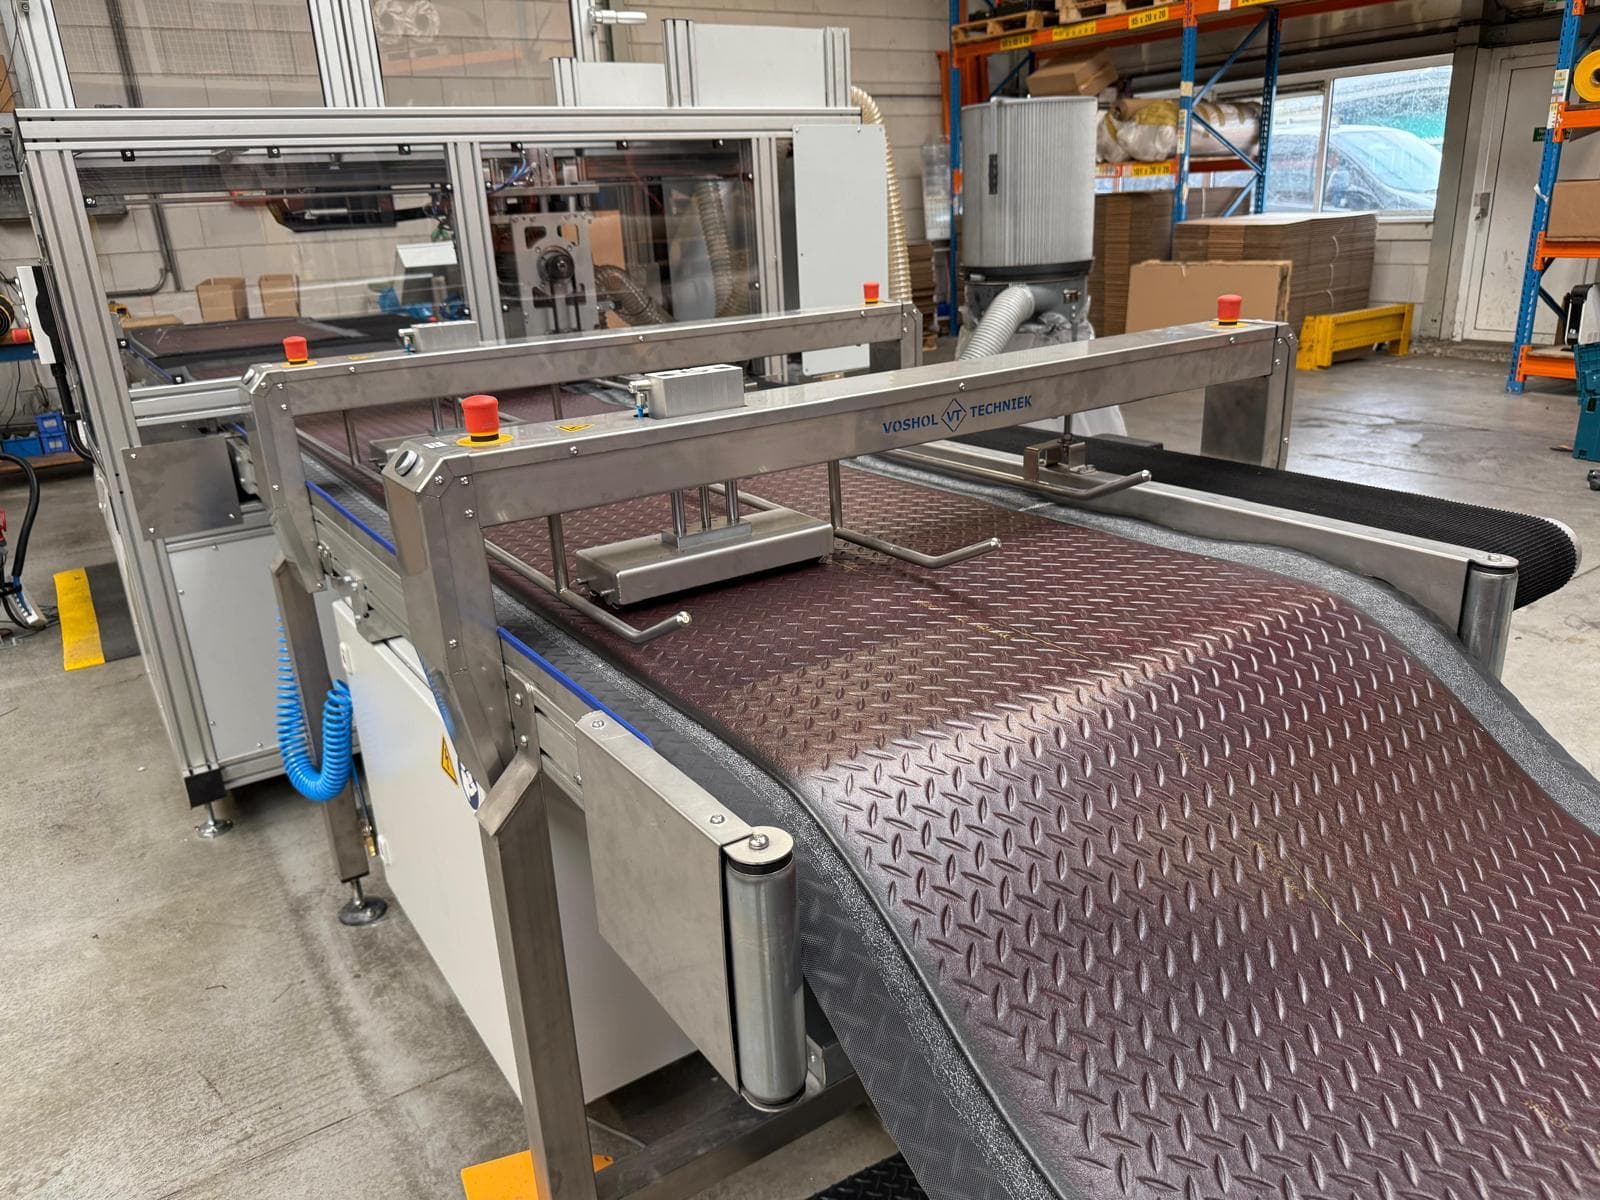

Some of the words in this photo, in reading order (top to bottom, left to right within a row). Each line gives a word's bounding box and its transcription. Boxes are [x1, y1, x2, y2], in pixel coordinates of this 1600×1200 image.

[883, 414, 938, 434] VOSHOL
[947, 409, 962, 422] VT
[970, 395, 1033, 417] TECHNIEK
